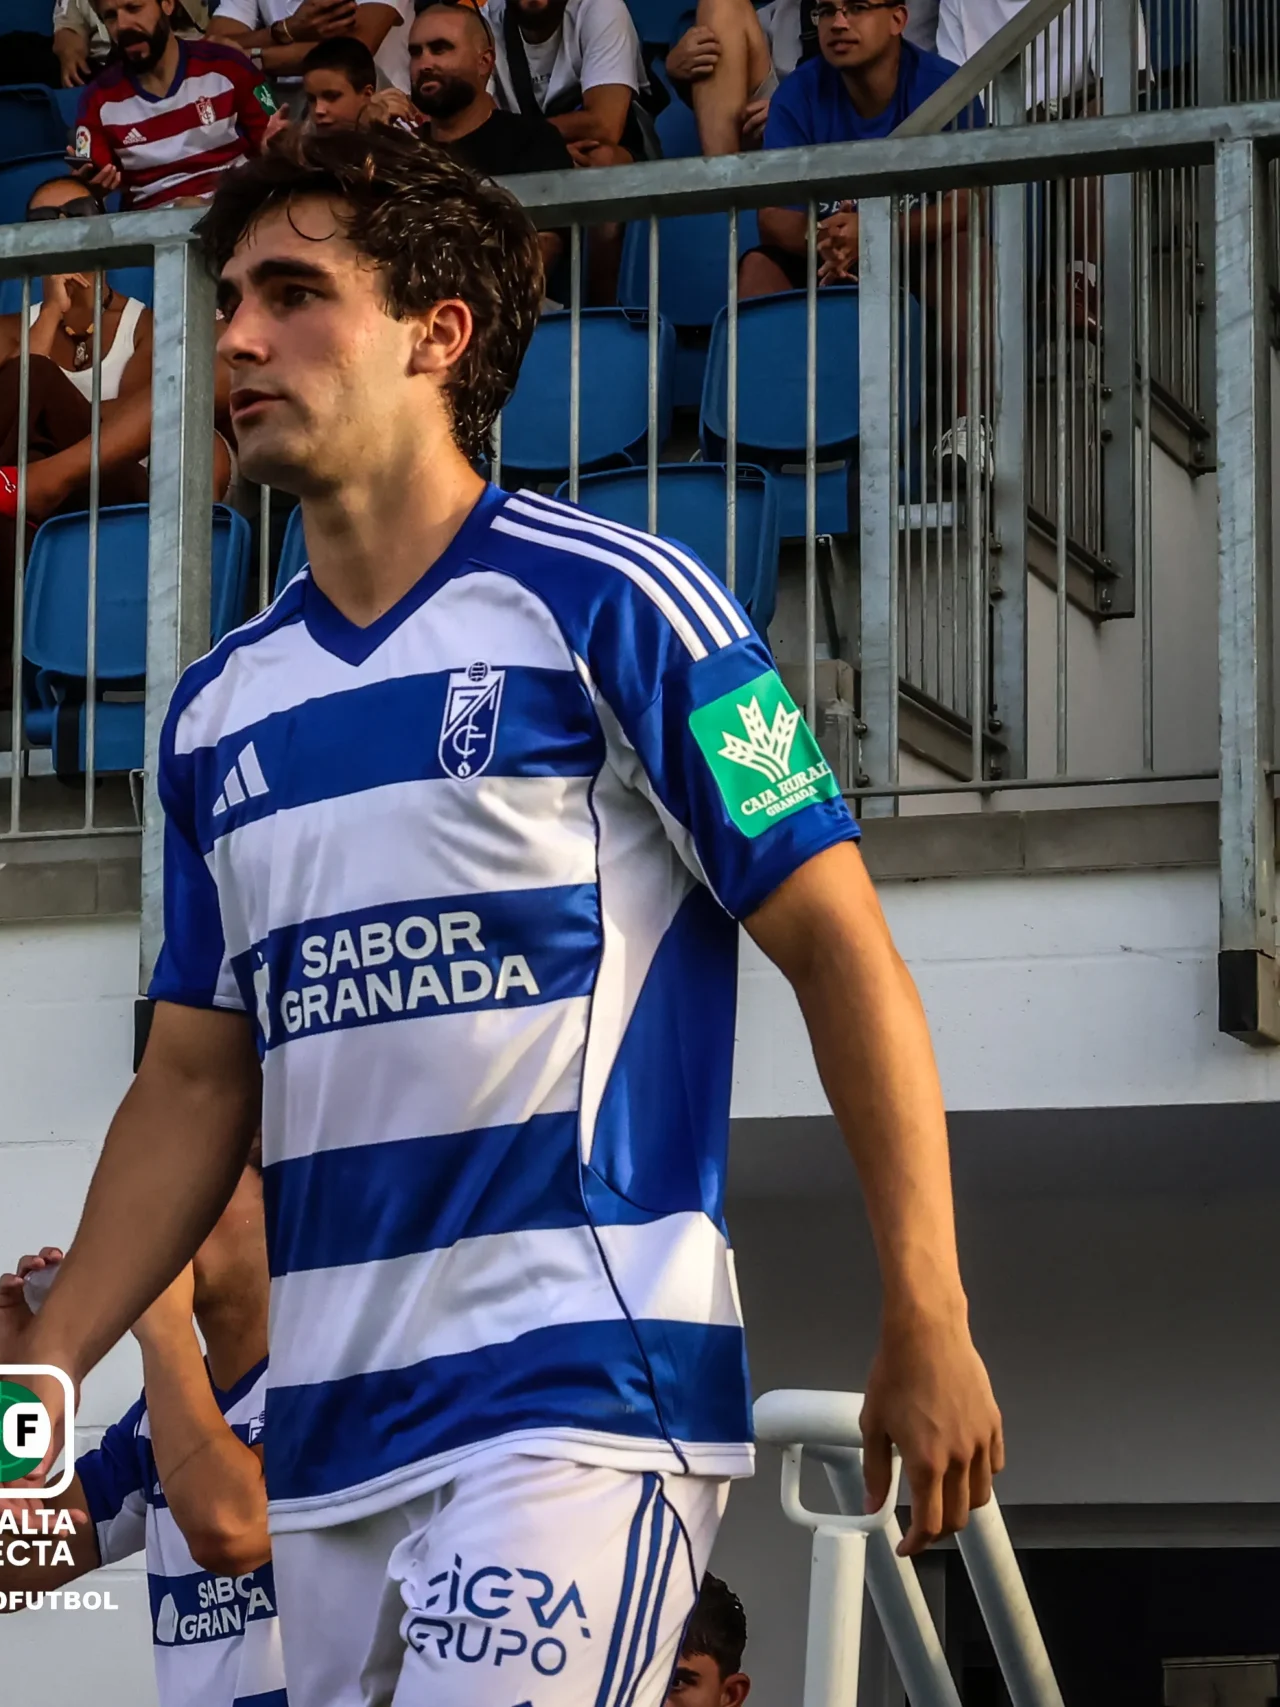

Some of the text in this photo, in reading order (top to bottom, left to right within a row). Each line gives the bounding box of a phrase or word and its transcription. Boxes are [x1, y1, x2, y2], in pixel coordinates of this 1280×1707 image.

[741, 761, 832, 816] CAJA RURAL
[766, 785, 818, 816] GRANADA
[301, 910, 486, 979] SABOR
[280, 954, 540, 1034] GRANADA
